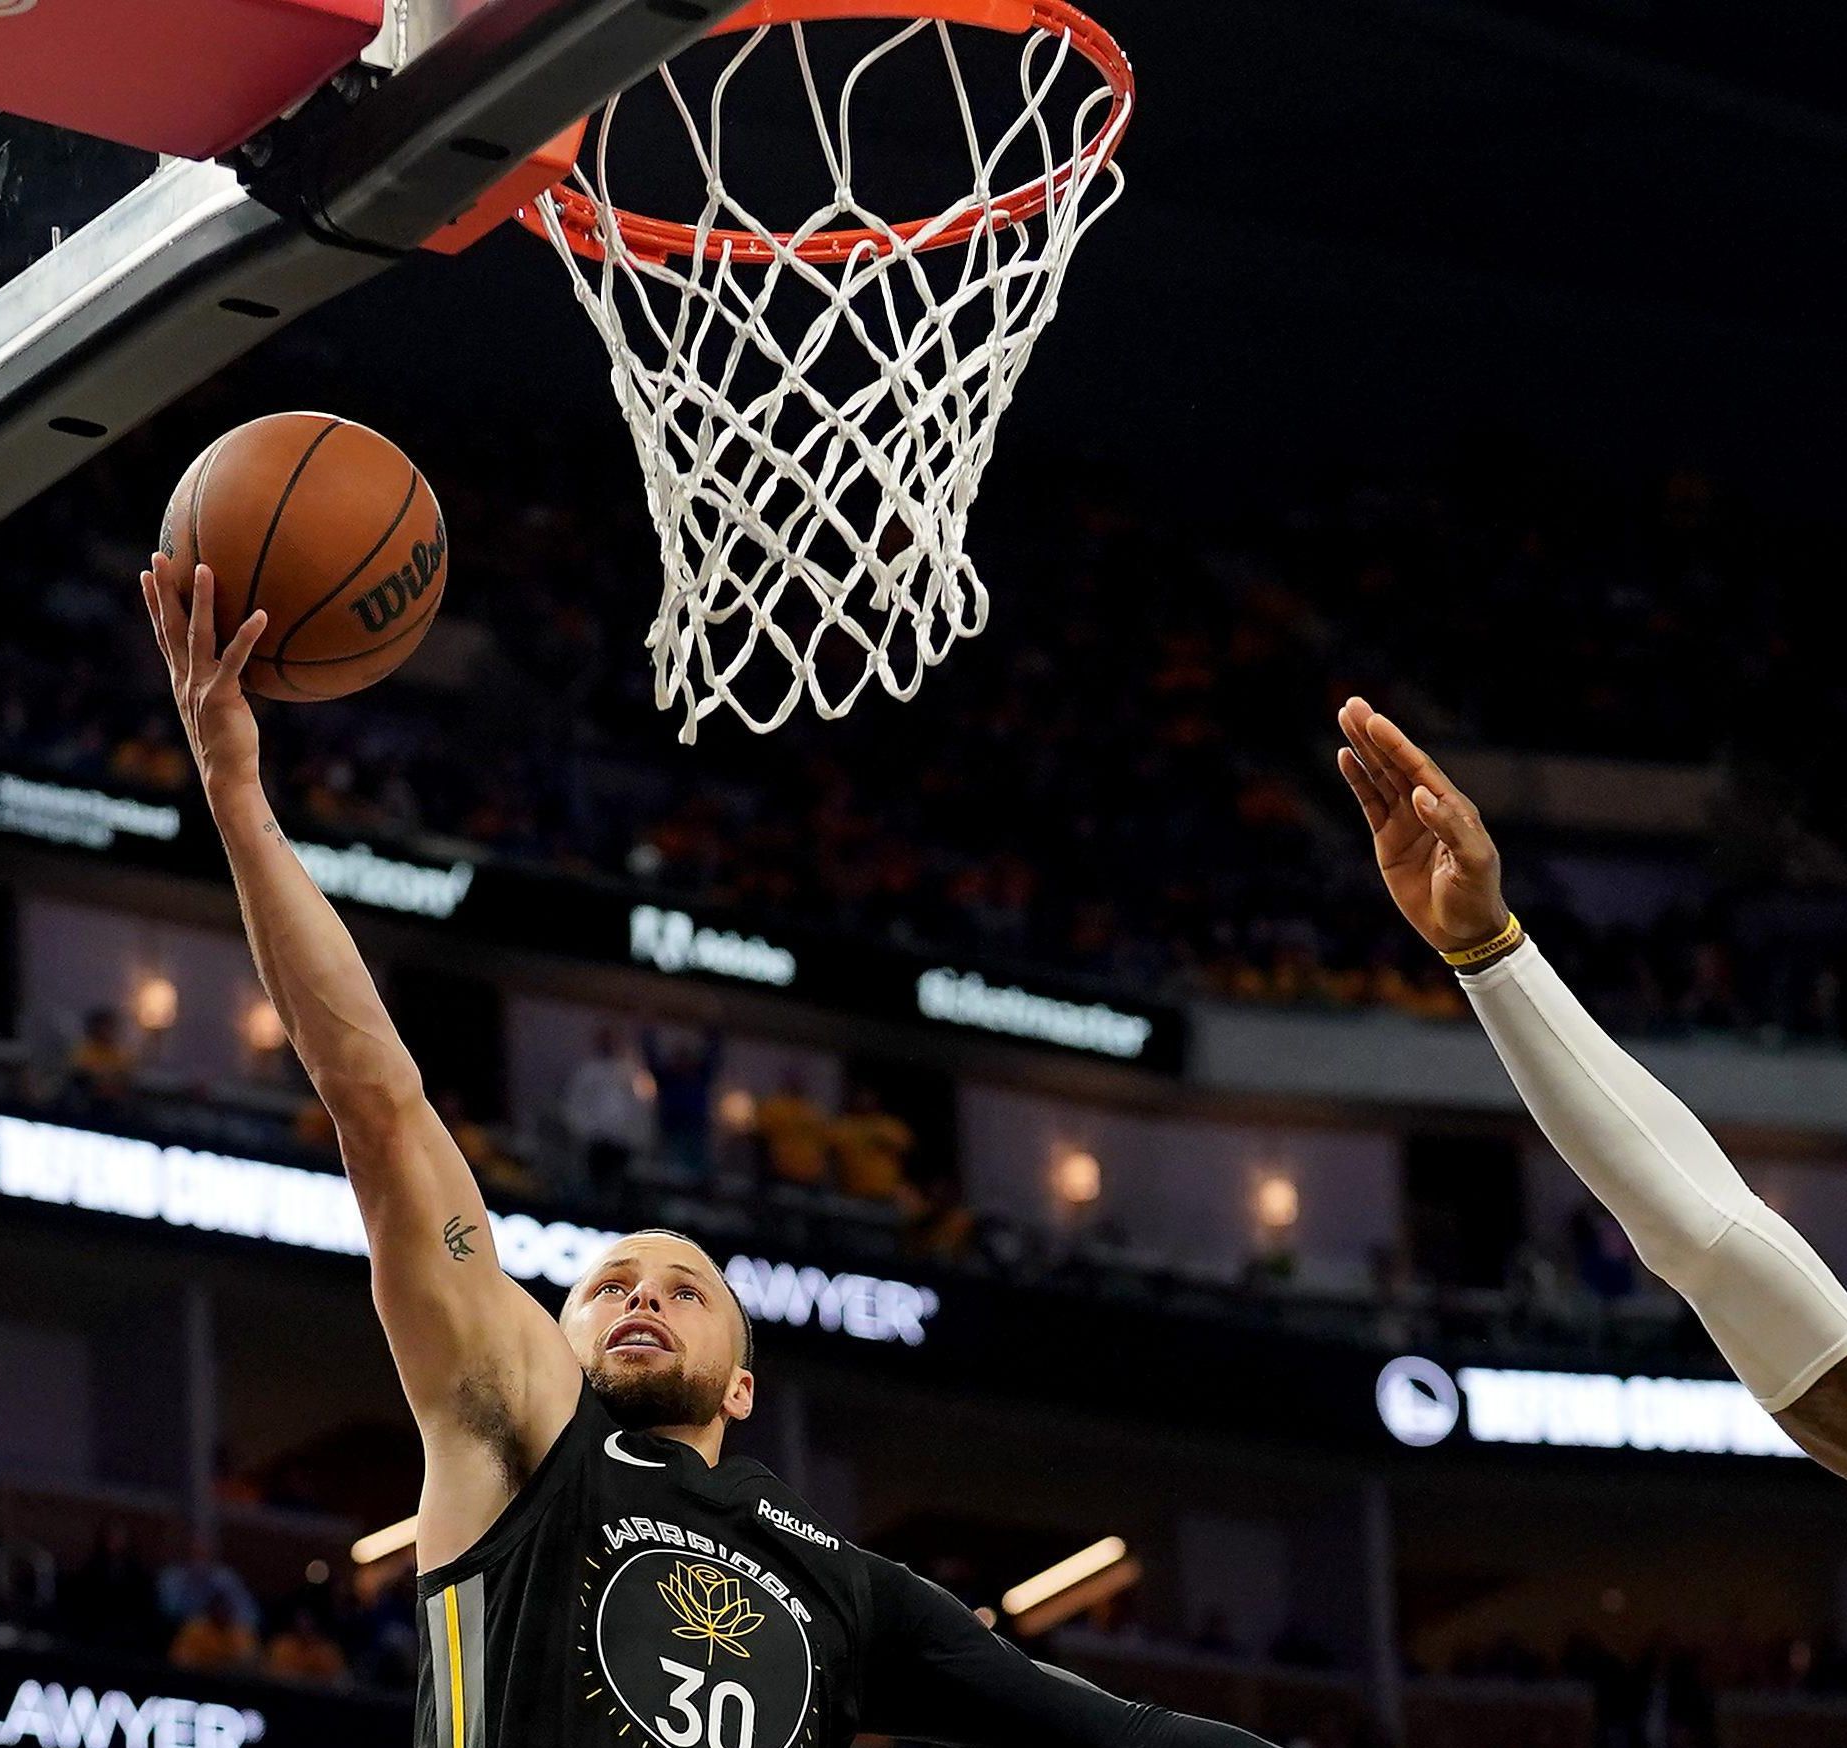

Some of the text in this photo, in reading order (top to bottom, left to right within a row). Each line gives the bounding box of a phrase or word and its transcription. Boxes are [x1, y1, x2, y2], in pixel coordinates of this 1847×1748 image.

[348, 512, 447, 632] Wilso
[602, 1516, 812, 1623] WARRIORS
[757, 1498, 840, 1551] Rakuten
